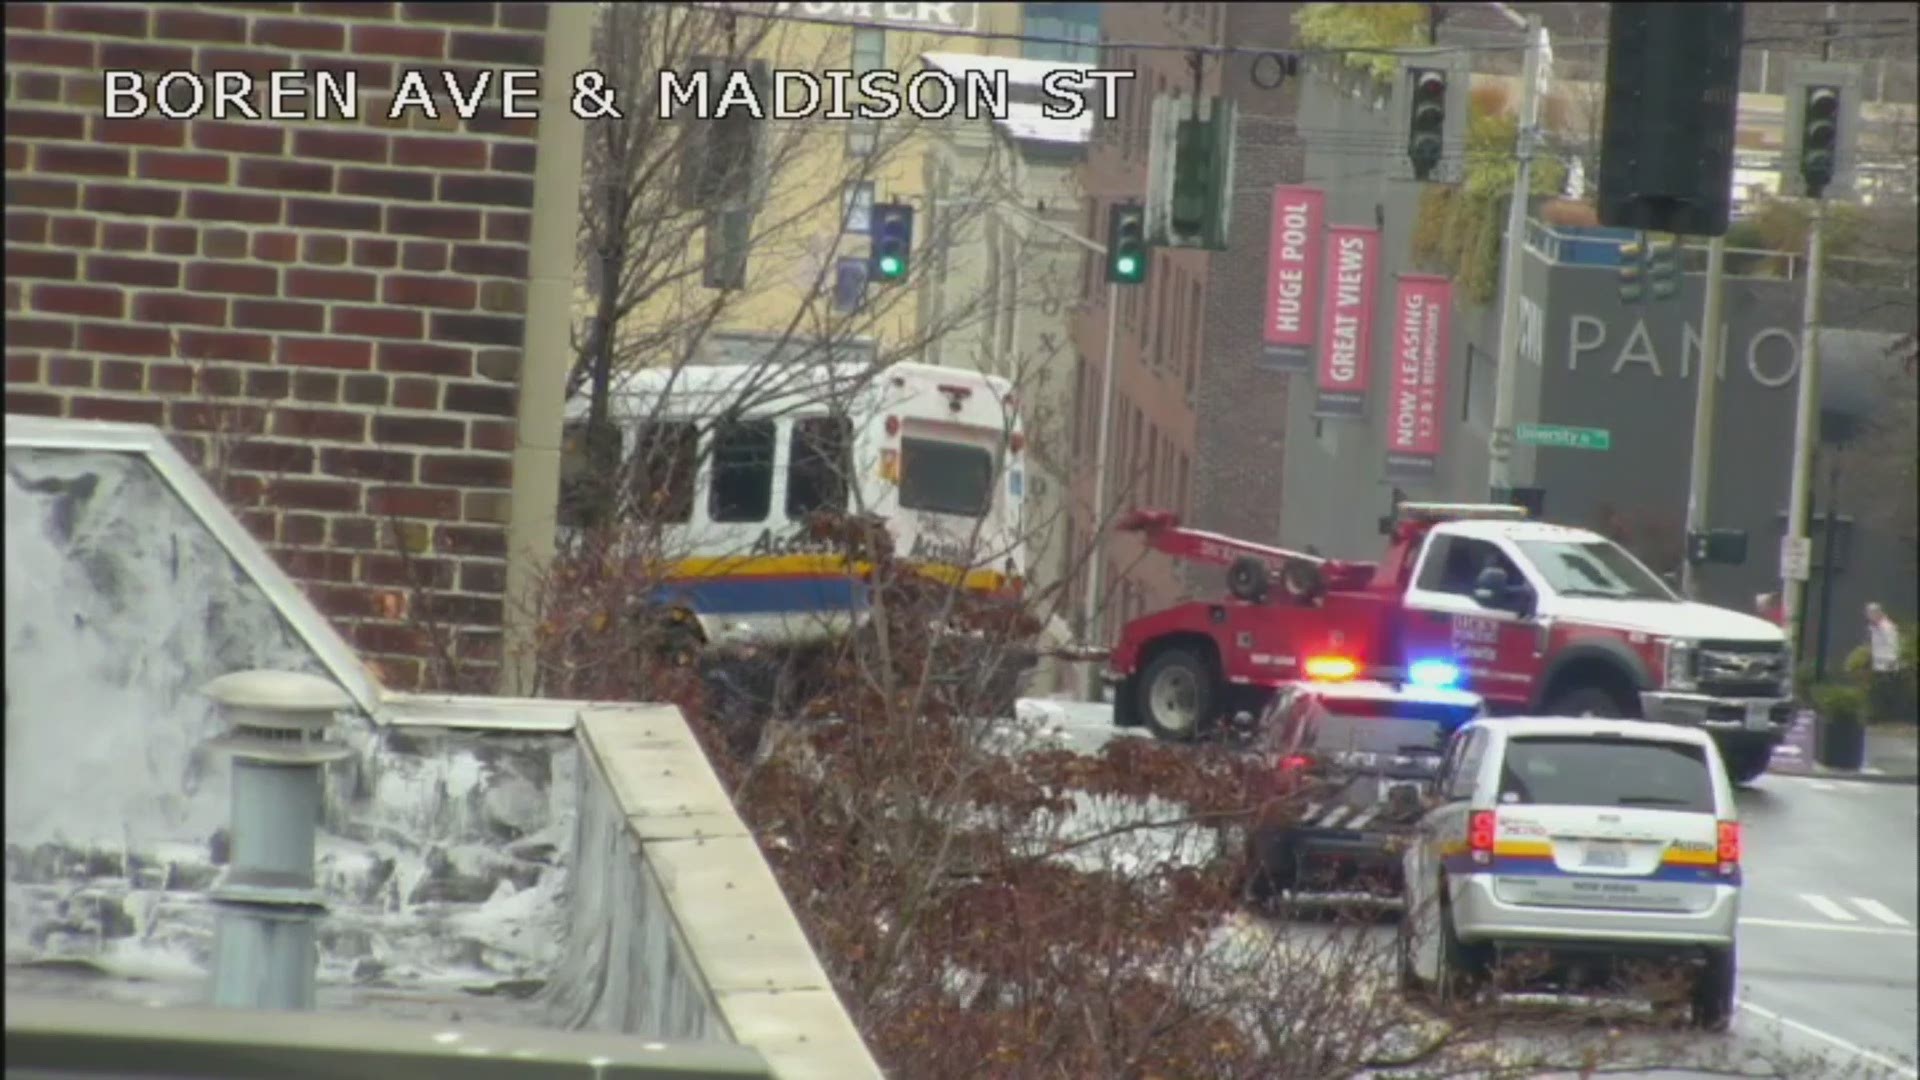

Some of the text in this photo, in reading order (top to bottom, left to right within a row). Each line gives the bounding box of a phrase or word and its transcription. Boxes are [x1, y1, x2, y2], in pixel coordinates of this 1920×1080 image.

[1282, 201, 1309, 260] POOL
[1276, 269, 1304, 332] HUGE
[1336, 237, 1365, 307] VIEWS
[1329, 315, 1359, 382] GREAT
[1401, 293, 1424, 386] LEASING
[1396, 391, 1417, 446] NOW
[1516, 424, 1579, 445] University
